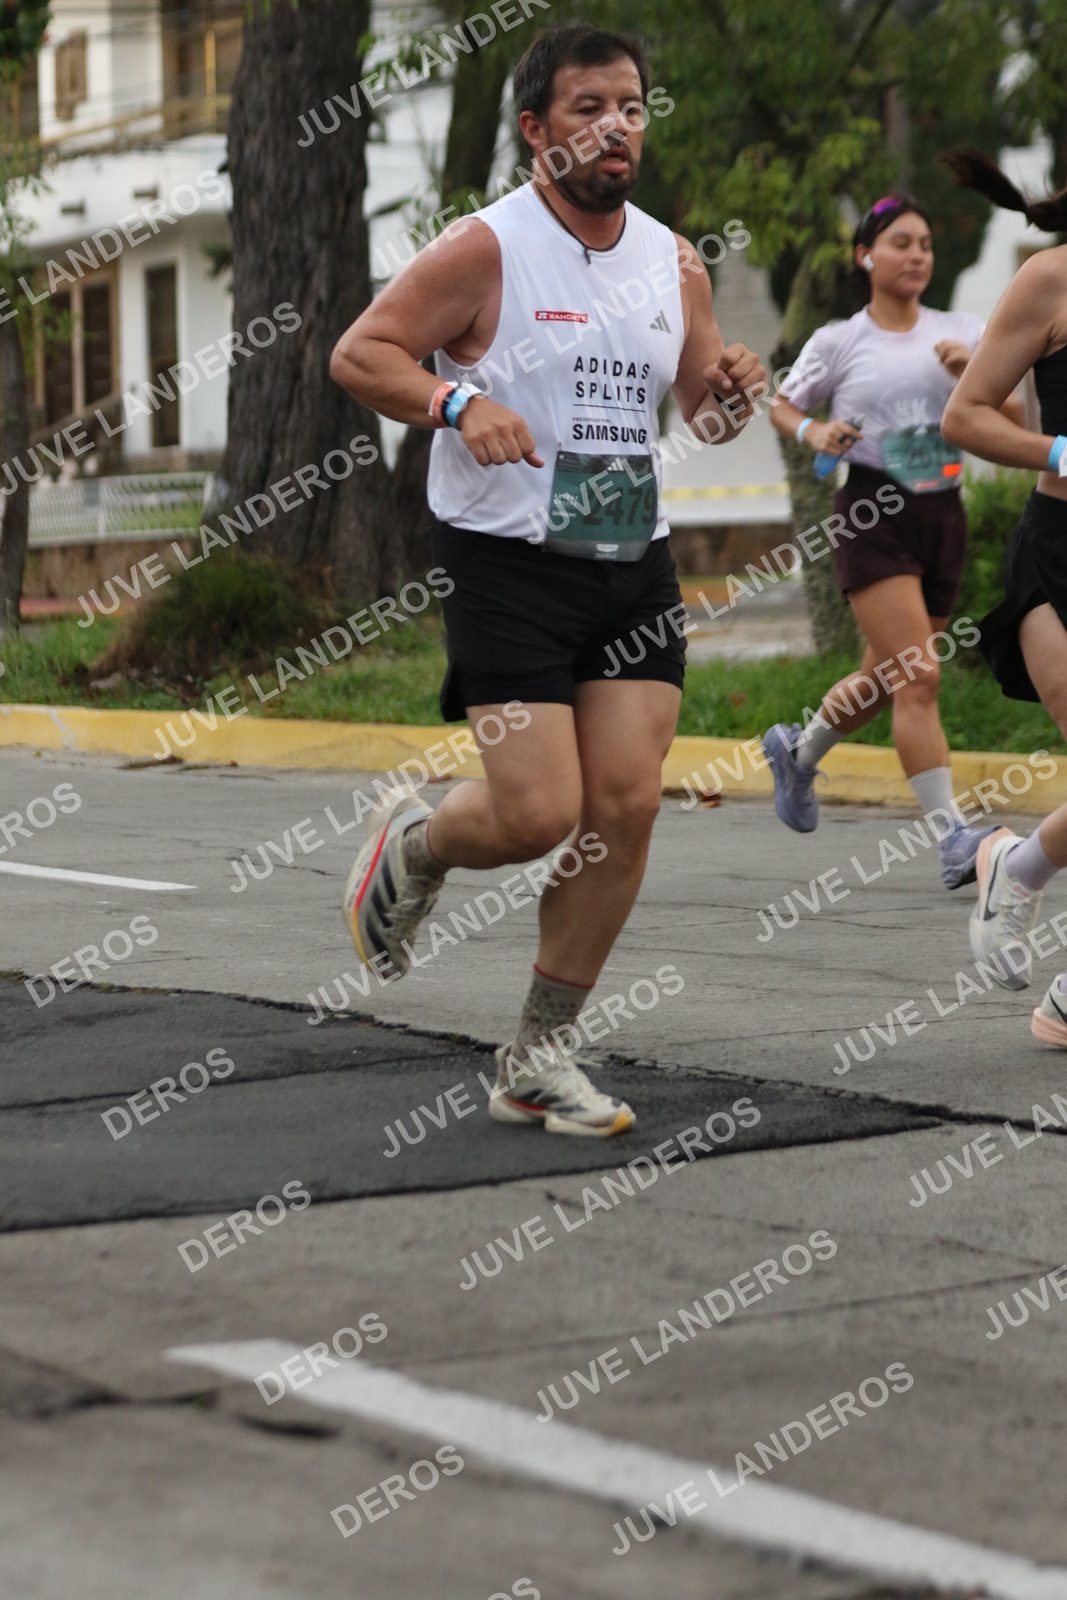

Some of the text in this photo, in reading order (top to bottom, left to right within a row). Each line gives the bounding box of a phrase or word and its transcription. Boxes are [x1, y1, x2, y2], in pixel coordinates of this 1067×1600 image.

[574, 356, 650, 380] ADIDAS
[575, 381, 646, 404] SPLITS
[572, 424, 648, 445] SAMSUNG
[584, 486, 655, 526] 2479
